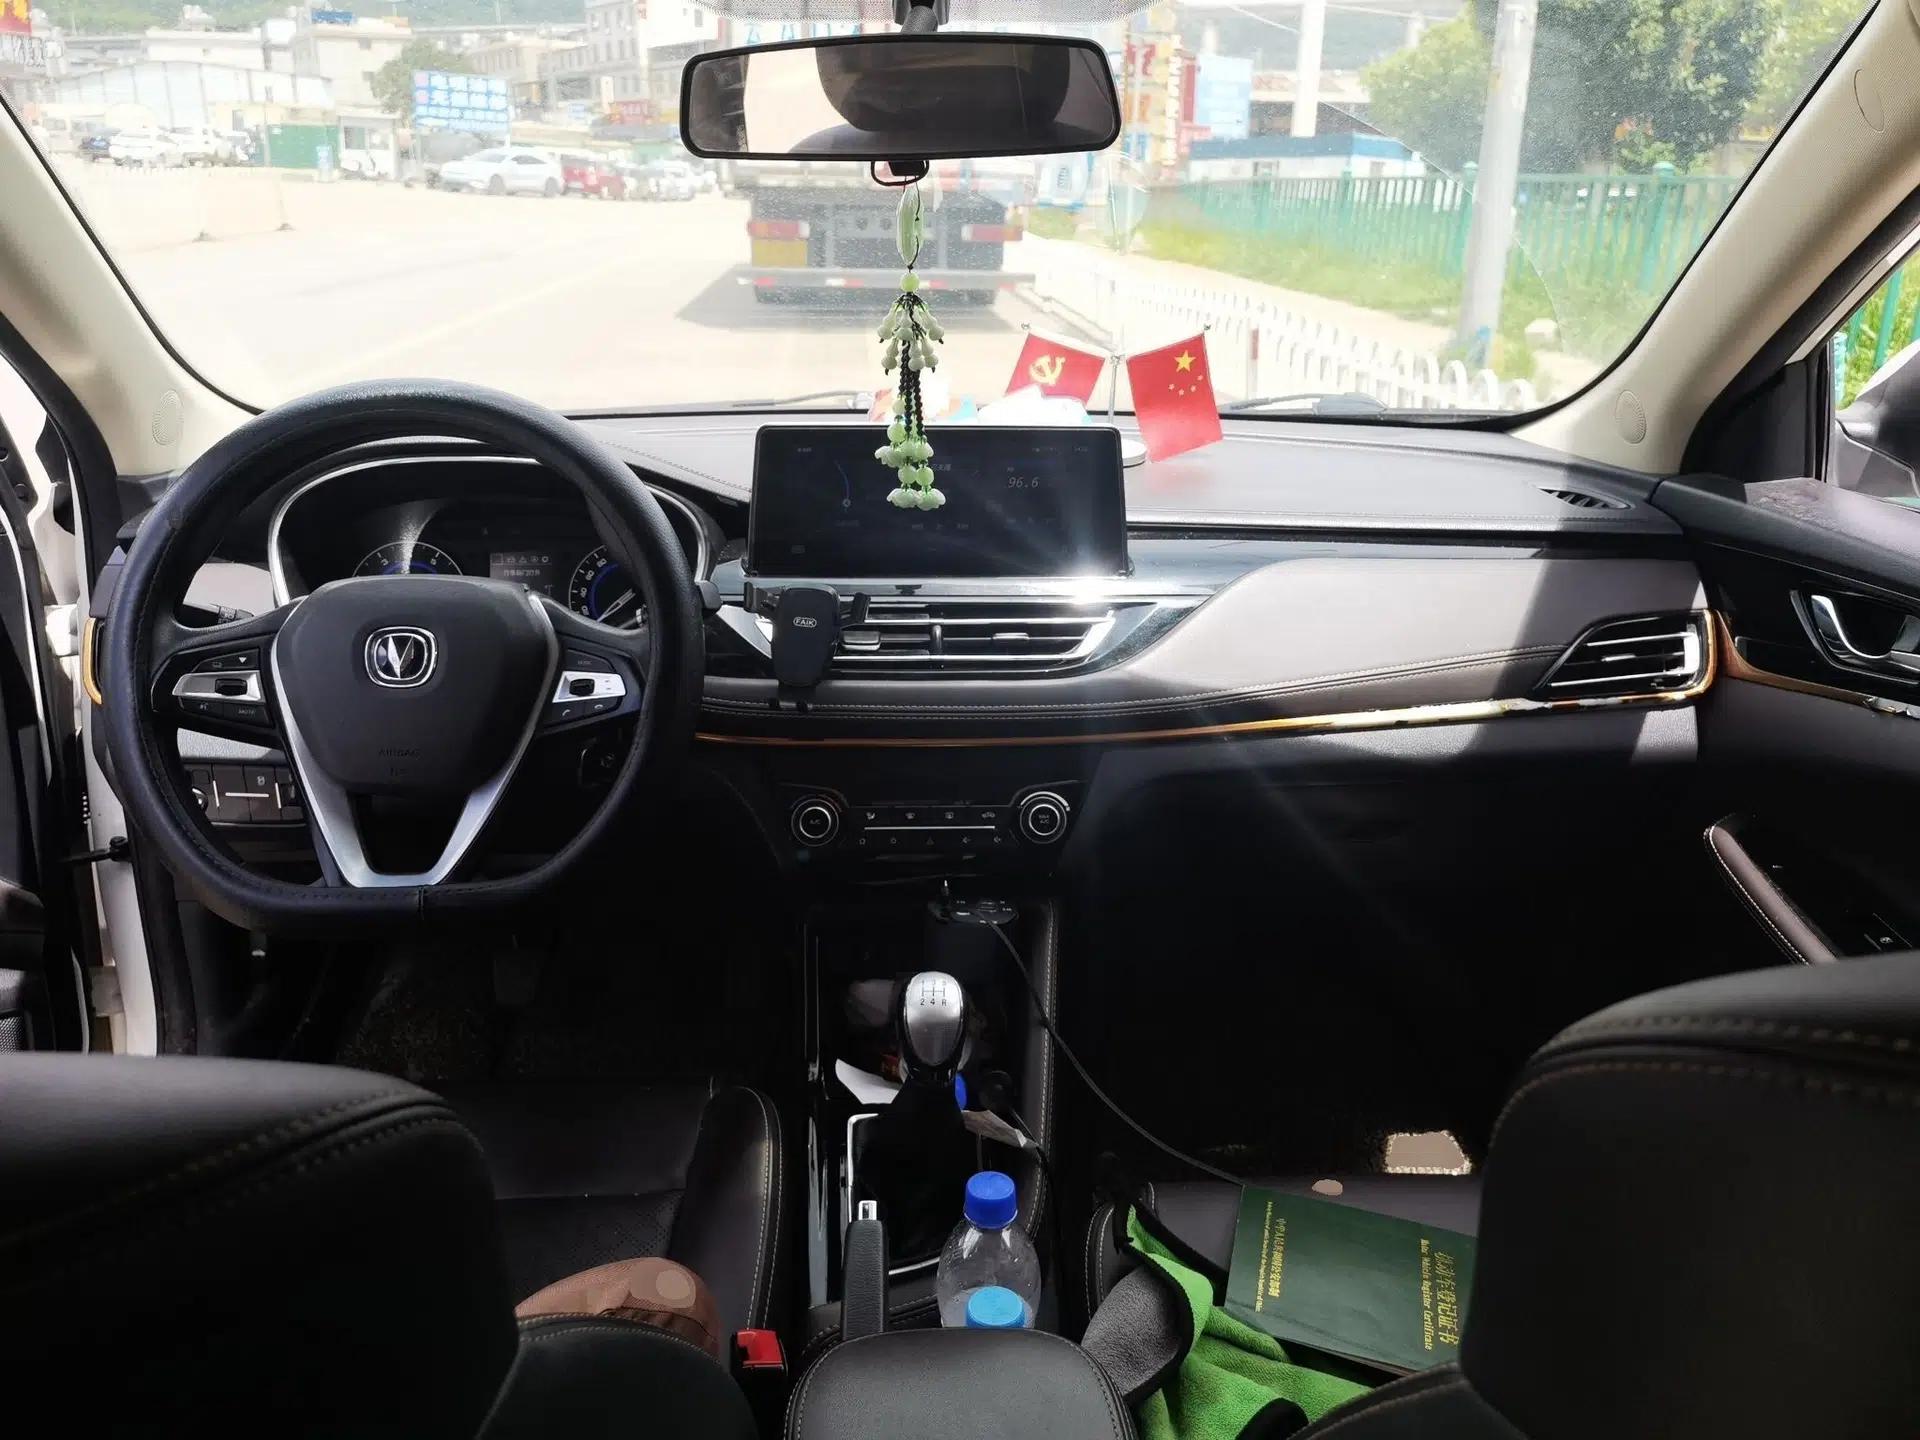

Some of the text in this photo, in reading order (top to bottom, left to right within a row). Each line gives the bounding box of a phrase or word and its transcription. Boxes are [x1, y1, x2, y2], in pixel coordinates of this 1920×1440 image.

[1007, 476, 1041, 489] 96.6
[795, 618, 815, 627] FAIK
[920, 998, 947, 1007] 2 4 R
[1421, 1280, 1433, 1309] Register
[1434, 1252, 1460, 1345] 机动车登记证书
[1423, 1310, 1435, 1351] Certificate
